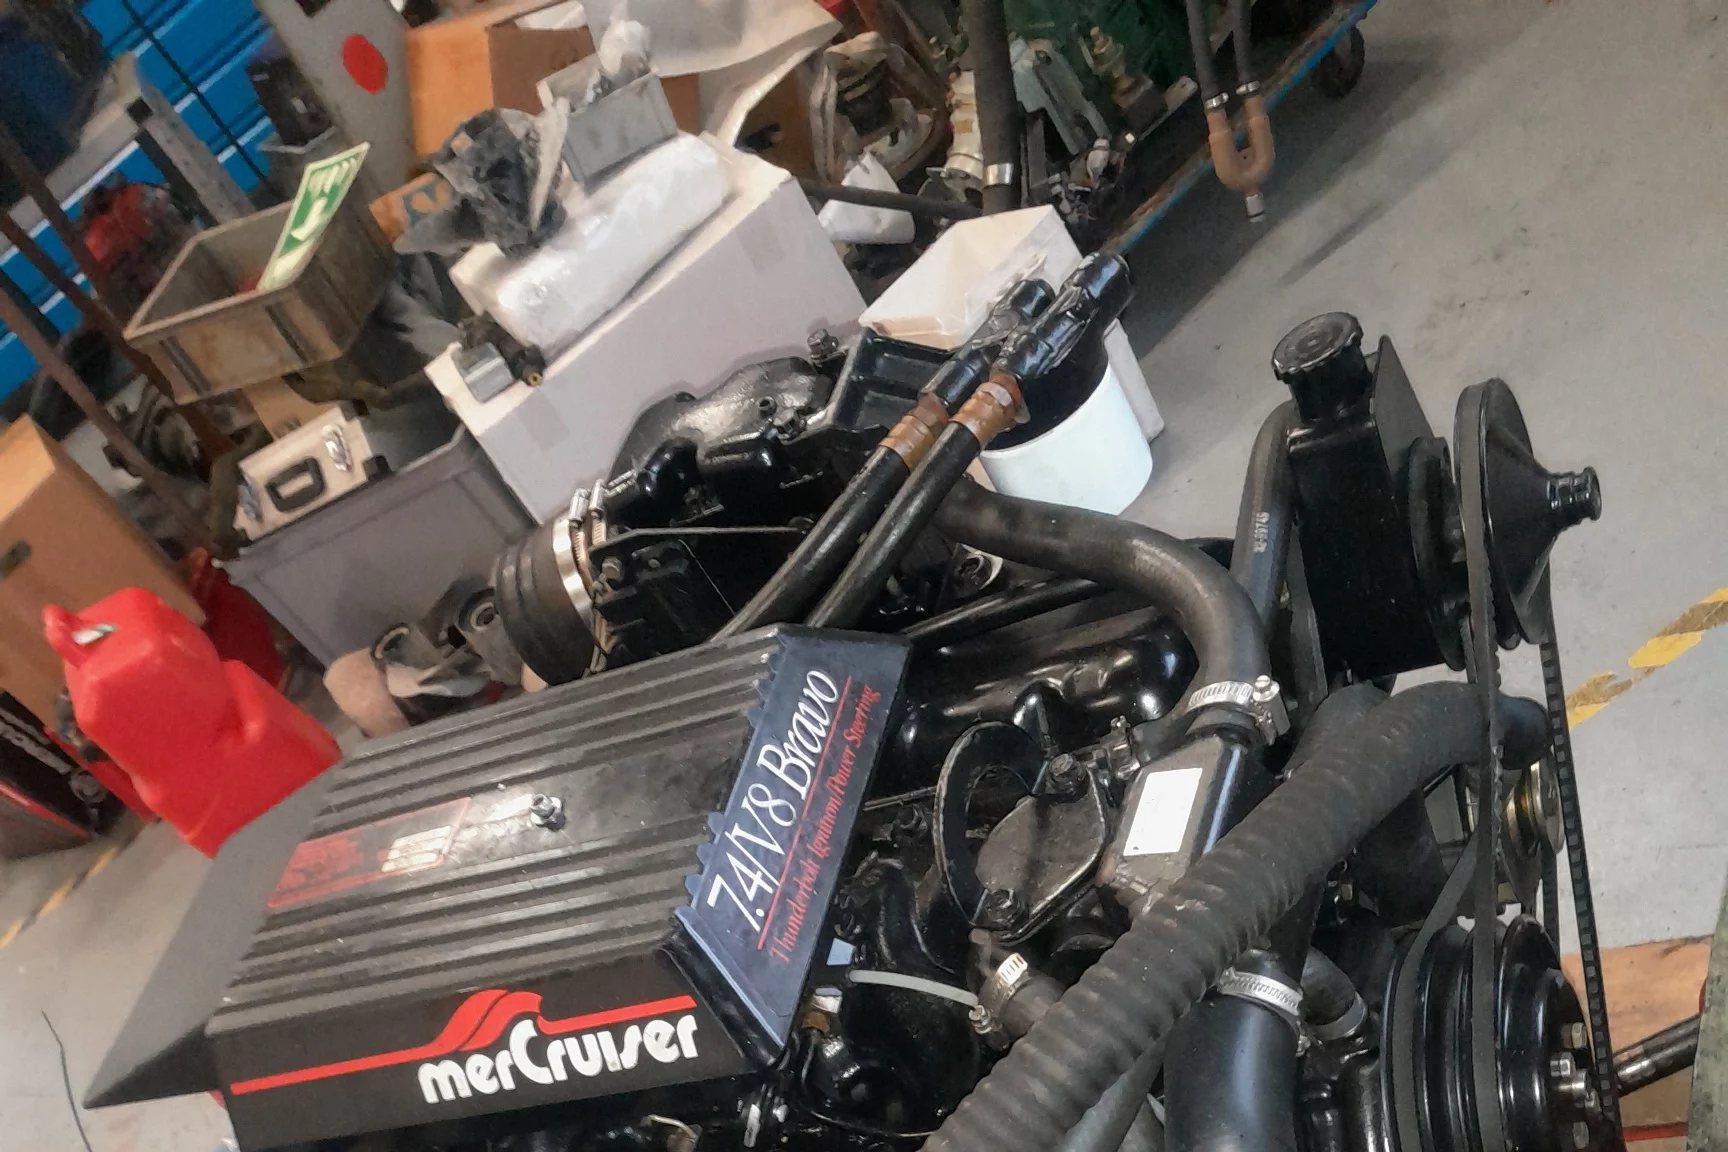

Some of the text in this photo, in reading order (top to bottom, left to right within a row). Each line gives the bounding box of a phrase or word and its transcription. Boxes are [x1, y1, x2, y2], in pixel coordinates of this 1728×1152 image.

[756, 669, 839, 800] Bravo
[769, 857, 821, 963] Thunderbolt
[843, 684, 881, 748] Steering
